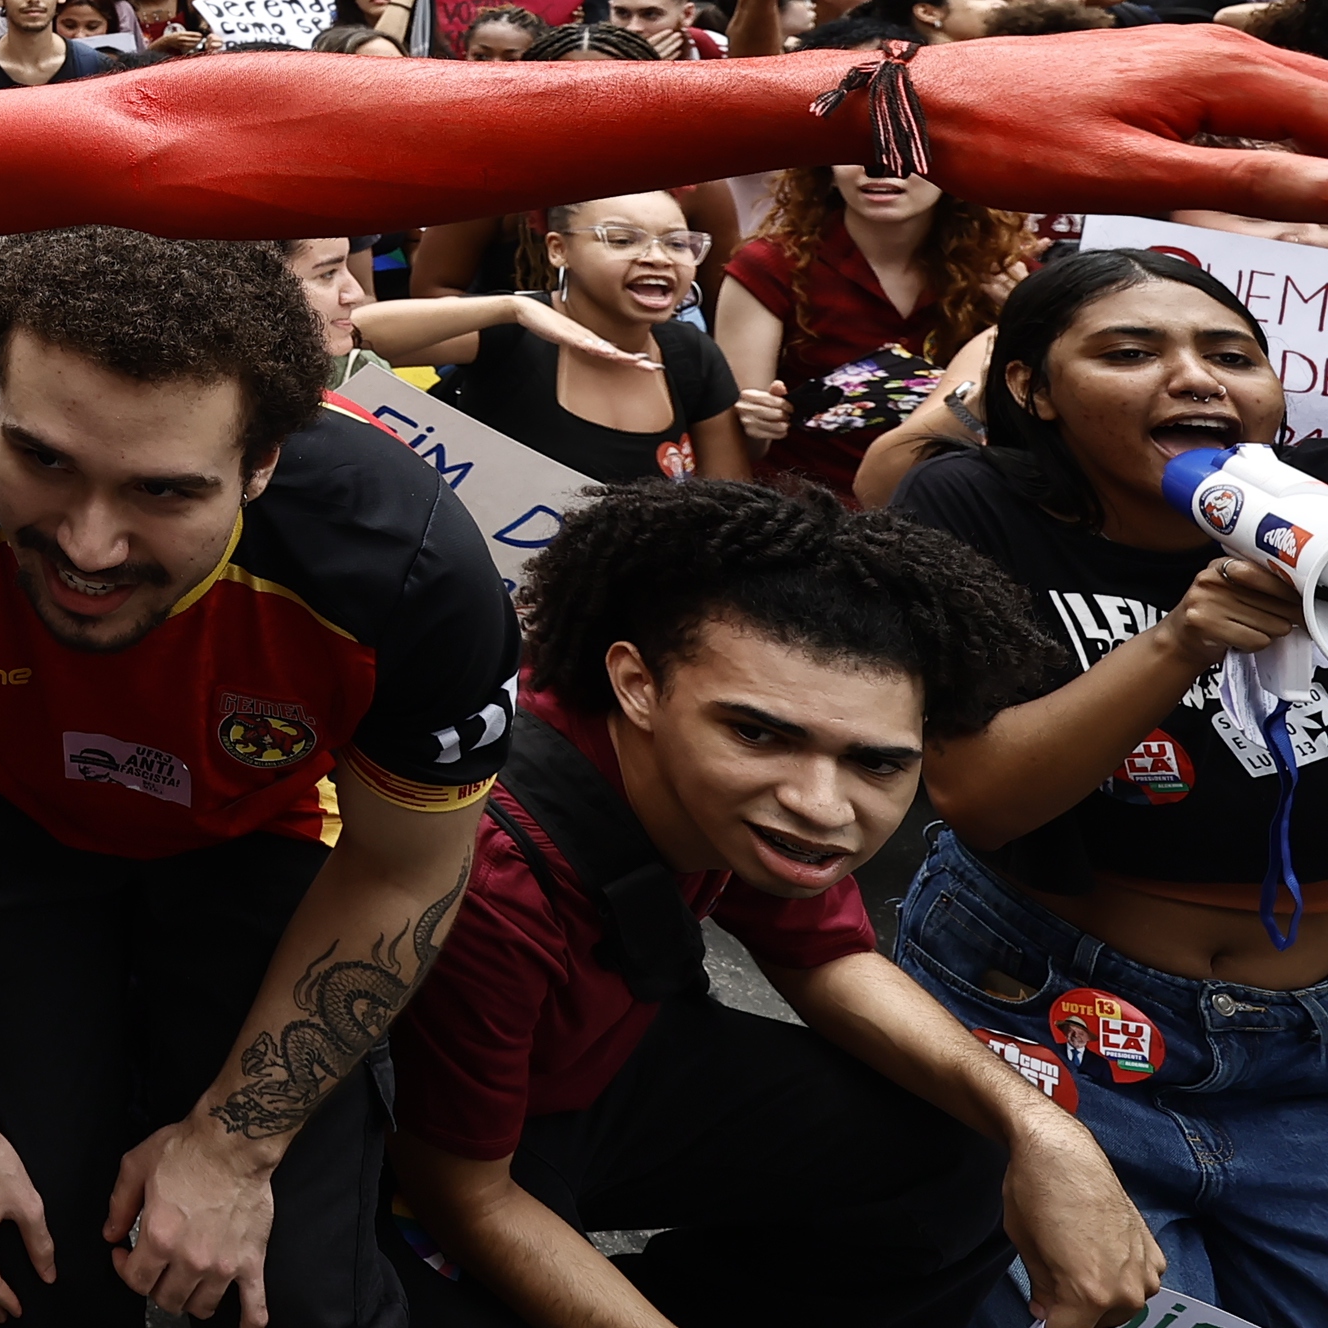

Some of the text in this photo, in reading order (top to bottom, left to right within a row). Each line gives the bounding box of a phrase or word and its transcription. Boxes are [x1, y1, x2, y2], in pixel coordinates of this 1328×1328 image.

[1263, 527, 1298, 559] FURIOSA
[135, 745, 174, 762] UFRJ
[1295, 741, 1317, 757] 13
[124, 754, 175, 778] ANTI
[118, 765, 181, 788] FASCISTA!
[1062, 1000, 1115, 1016] VOTE 13
[1105, 1050, 1143, 1061] PRESIDENTE
